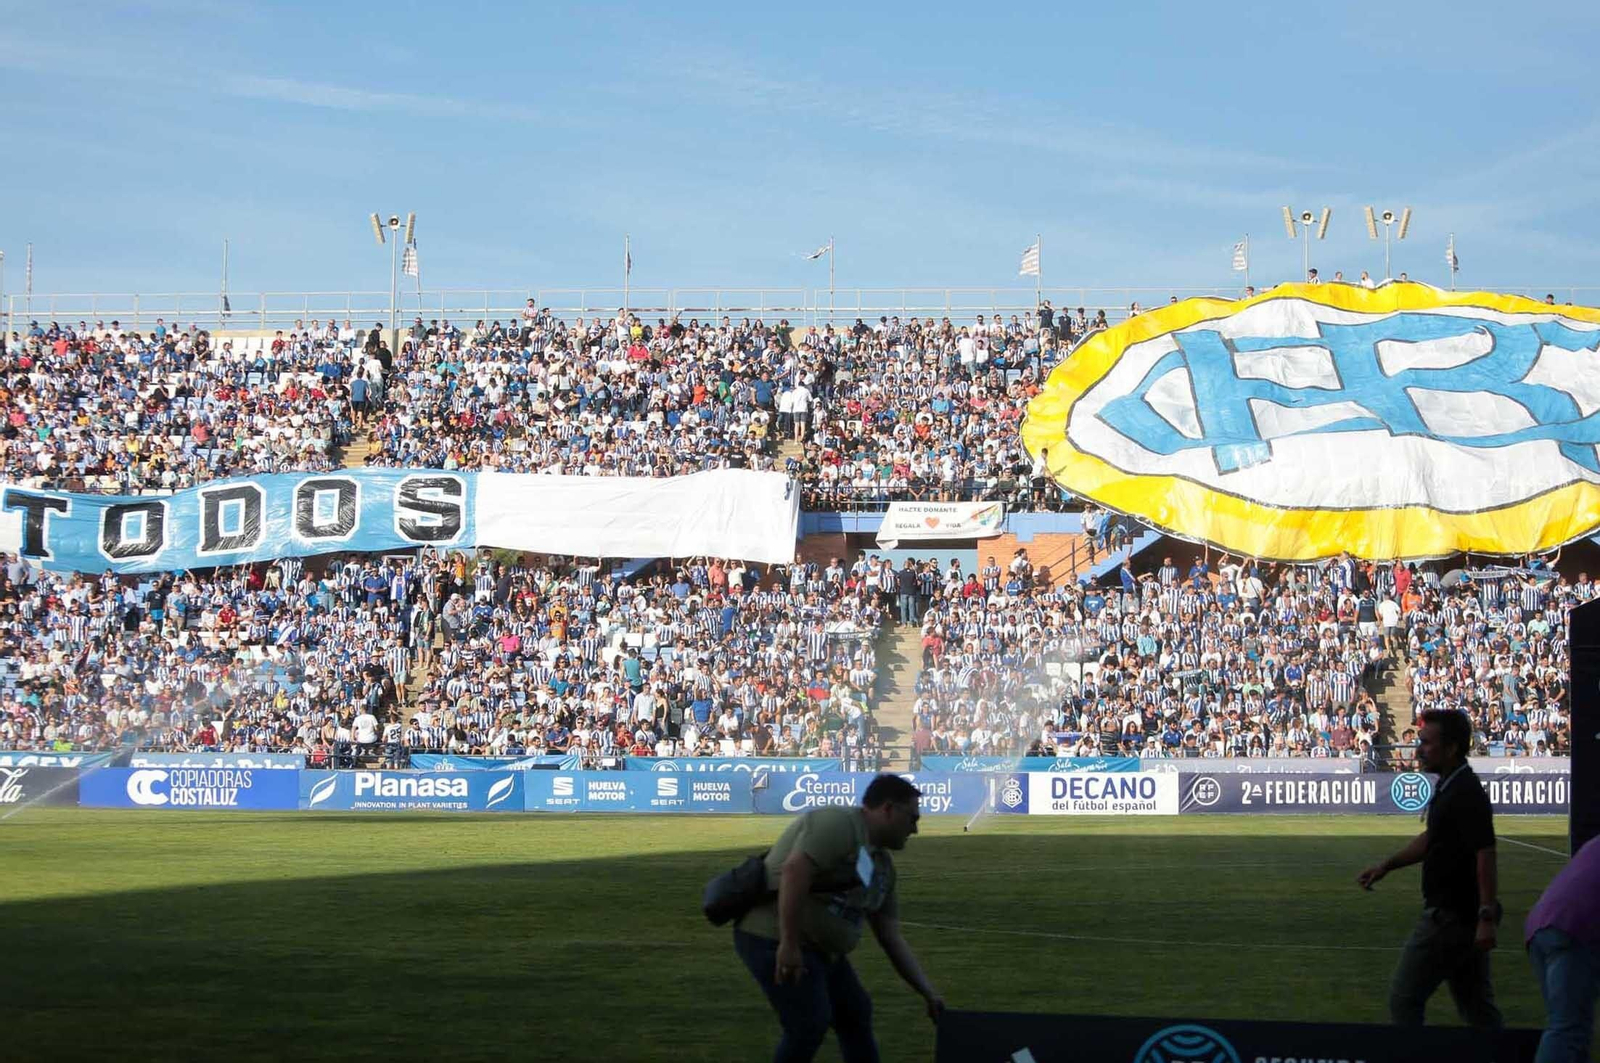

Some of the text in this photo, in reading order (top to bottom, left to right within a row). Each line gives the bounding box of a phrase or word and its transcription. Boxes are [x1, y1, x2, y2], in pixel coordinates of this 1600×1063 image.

[3, 476, 465, 561] TODOS
[170, 769, 252, 788] COPIADORAS
[355, 772, 468, 797] Planasa
[588, 781, 626, 790] HUELVA
[693, 782, 731, 791] HUELVA
[170, 788, 238, 806] COSTALUZ
[588, 792, 626, 801] MOTOR
[693, 792, 731, 801] MOTOR
[1051, 776, 1156, 800] DECANO
[1265, 775, 1376, 804] FEDERACIÓN
[1483, 776, 1570, 804] DERACIÓ
[1052, 799, 1157, 813] del fútbol español
